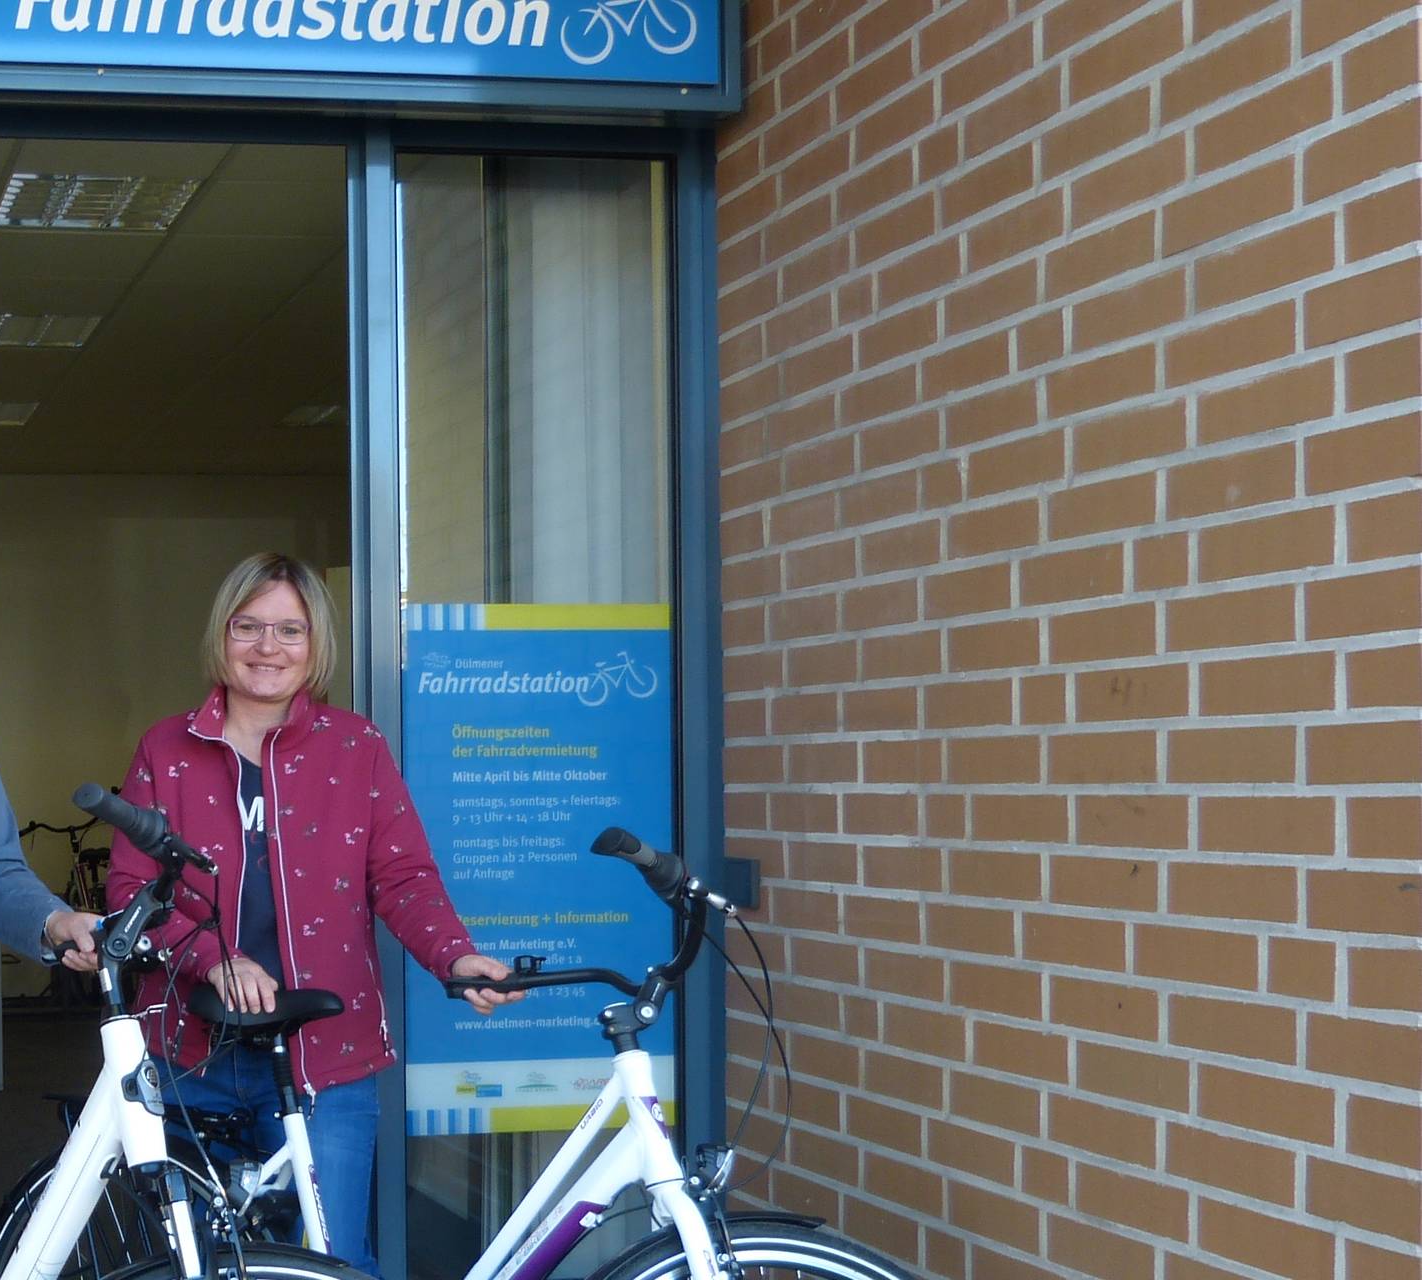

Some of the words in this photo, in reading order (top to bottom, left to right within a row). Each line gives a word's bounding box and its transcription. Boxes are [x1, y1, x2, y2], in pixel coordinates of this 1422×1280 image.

[455, 657, 504, 669] Dülmener
[418, 671, 589, 694] Fahrradstation
[451, 723, 550, 741] Öffnungszeiten
[451, 745, 474, 758] der
[477, 743, 598, 759] Fahrradvermietung
[452, 771, 482, 783] Mitte
[484, 770, 510, 784] April
[513, 769, 529, 782] bis
[532, 770, 561, 782] Mitte
[563, 769, 608, 781] Oktober
[452, 797, 507, 808] samstags,
[509, 796, 559, 808] sonntags
[570, 794, 621, 807] feiertags:
[452, 815, 460, 826] 9
[470, 814, 481, 825] 13
[484, 812, 504, 824] Uhr
[516, 813, 528, 824] 14
[537, 811, 550, 823] 18
[552, 811, 571, 823] Uhr
[453, 837, 500, 849] montags
[502, 836, 519, 848] bis
[521, 836, 566, 849] freitags:
[453, 852, 499, 866] Gruppen
[502, 852, 516, 864] ab
[518, 854, 525, 864] 2
[528, 851, 578, 863] Personen
[453, 868, 471, 881] auf
[473, 868, 515, 881] Anfrage
[555, 911, 629, 925] Information
[499, 938, 555, 953] Marketing
[557, 938, 578, 949] e.V.
[454, 1016, 601, 1030] www.duelmen-marketing.
